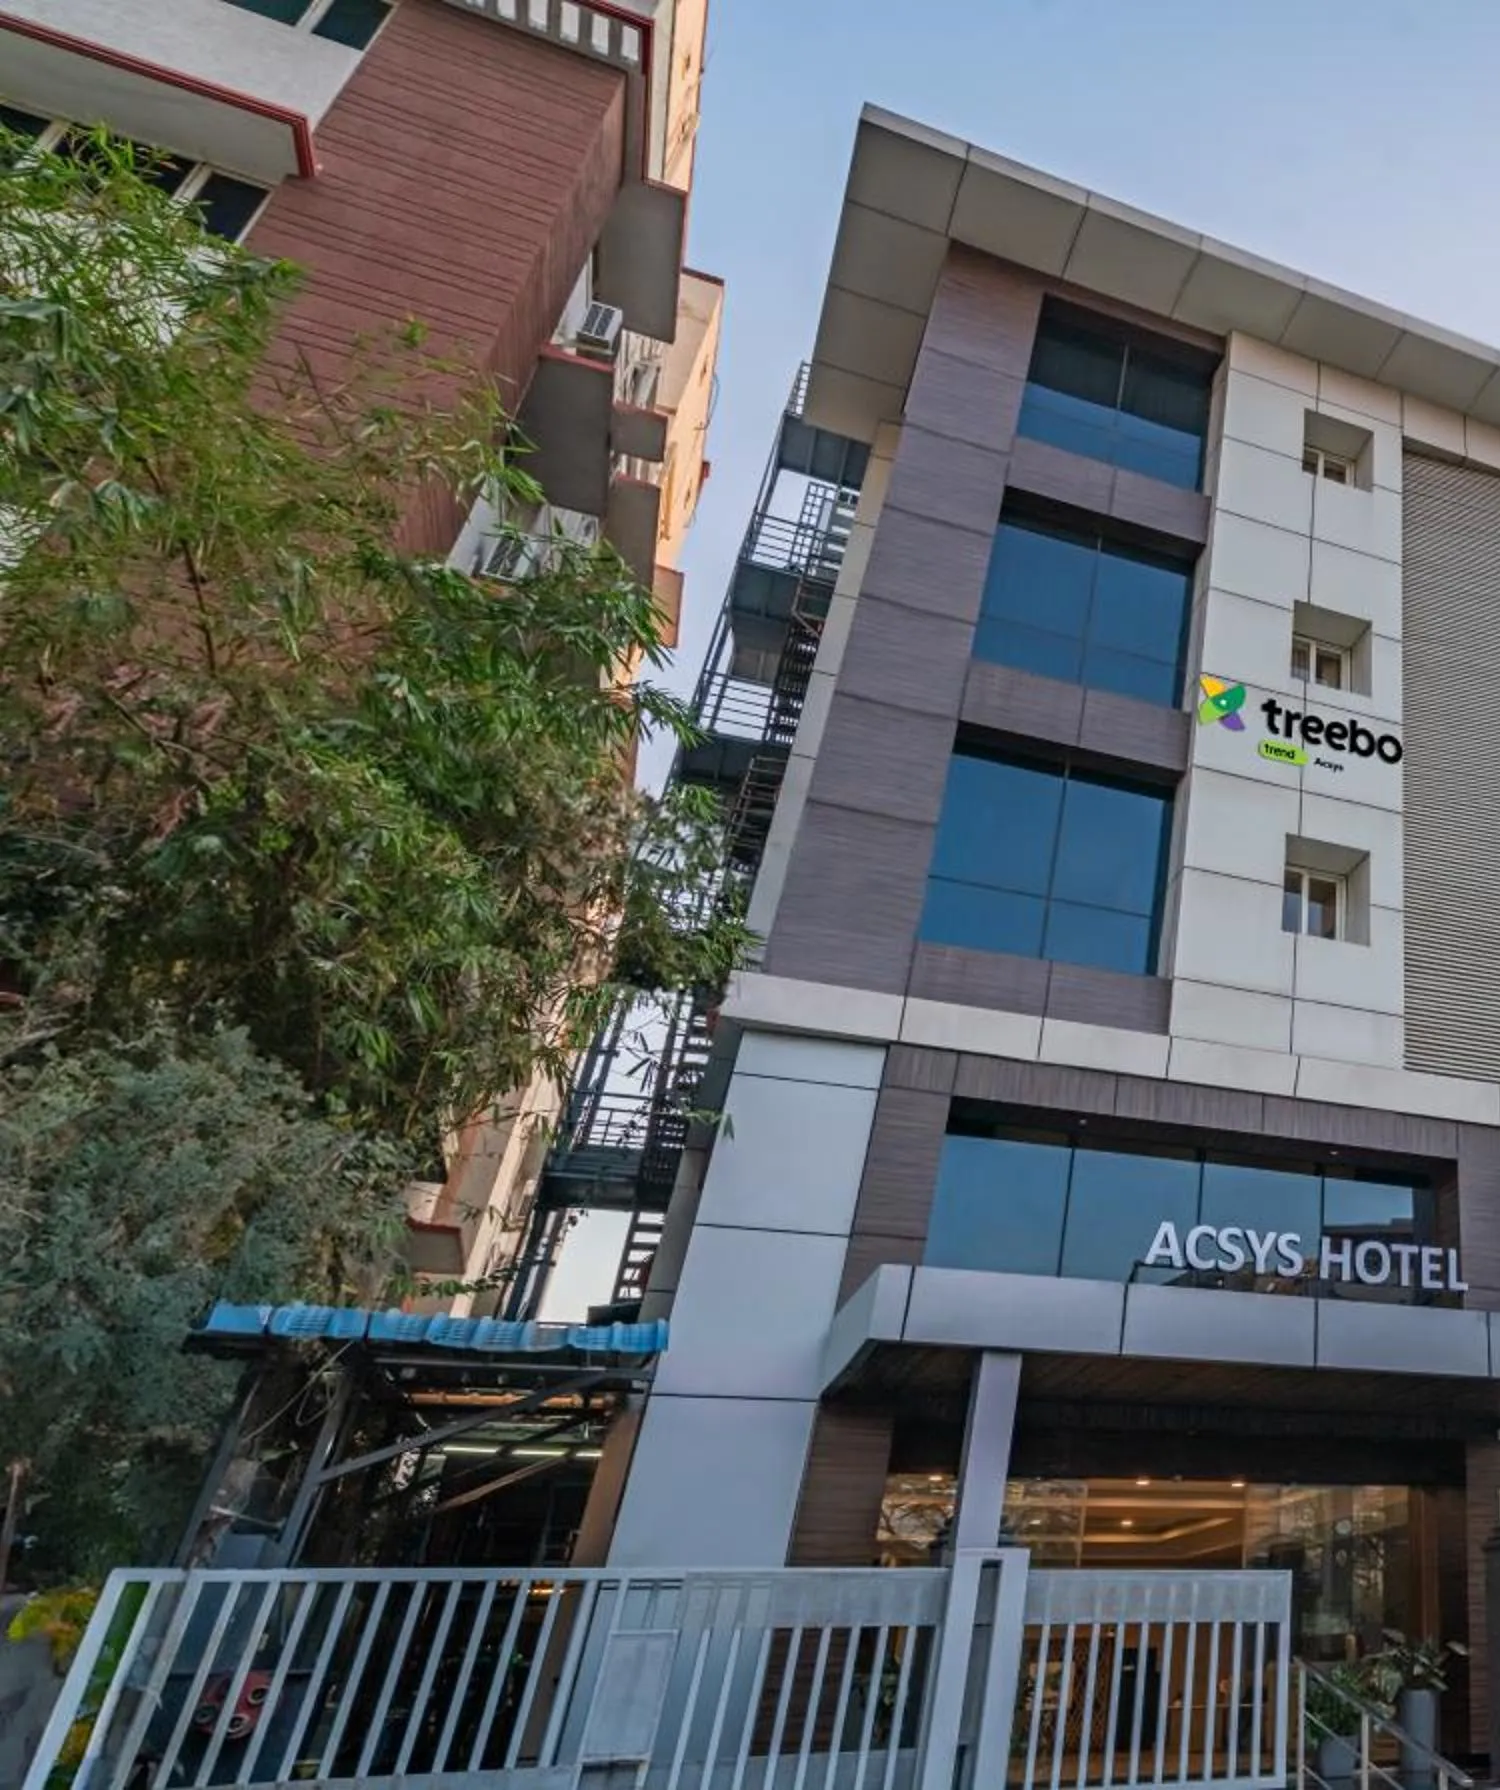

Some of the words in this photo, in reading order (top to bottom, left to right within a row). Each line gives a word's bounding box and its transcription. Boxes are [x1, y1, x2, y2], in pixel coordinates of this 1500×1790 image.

[1261, 698, 1403, 765] treebo
[1264, 743, 1297, 760] trend
[1144, 1221, 1304, 1277] ACSYS
[1319, 1236, 1469, 1291] HOTEL
